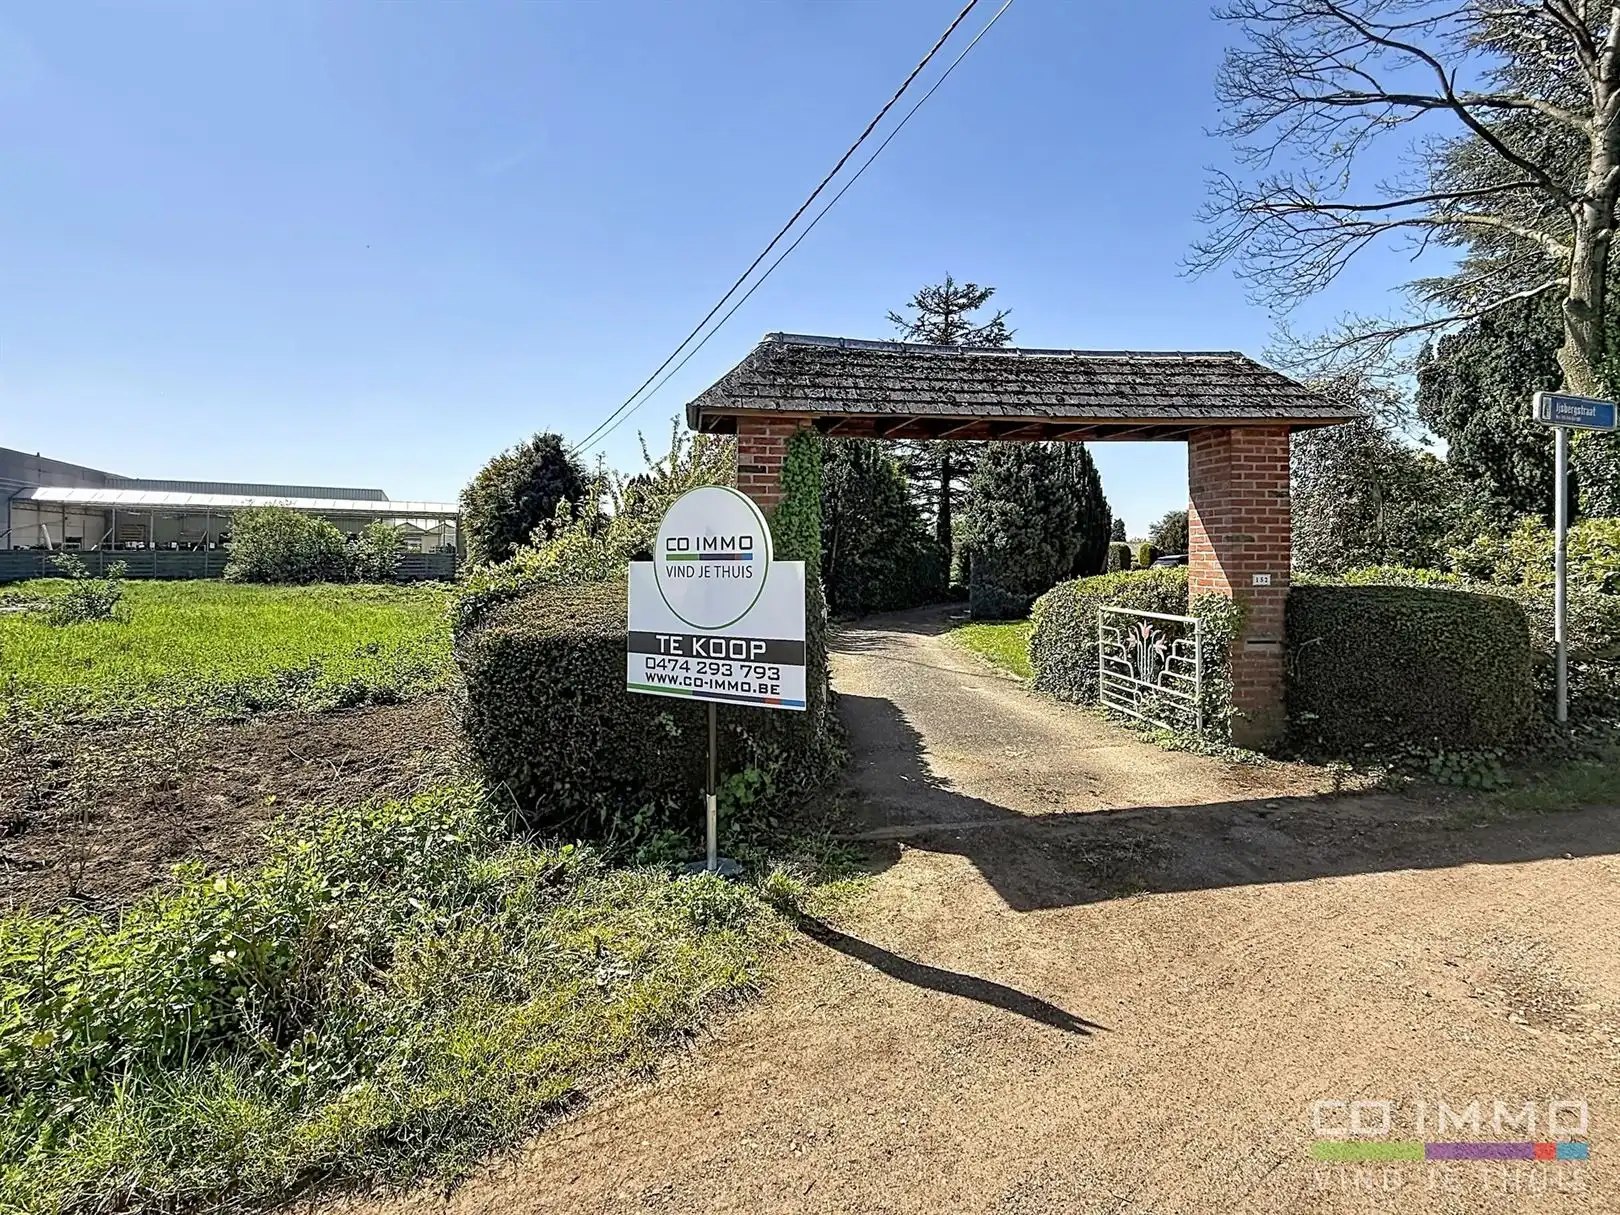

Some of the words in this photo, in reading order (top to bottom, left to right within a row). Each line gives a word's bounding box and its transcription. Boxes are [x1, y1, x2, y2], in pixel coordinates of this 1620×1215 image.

[666, 537, 690, 551] CO
[696, 535, 753, 551] IMMO
[666, 565, 695, 578] VIND
[697, 565, 711, 579] JE
[713, 565, 753, 579] THUIS
[655, 634, 683, 655] TE
[692, 636, 767, 660] KOOP
[645, 657, 691, 673] 0474
[696, 661, 733, 677] 293
[740, 664, 781, 681] 793
[645, 671, 781, 696] WWW.CO-IMMO.BE
